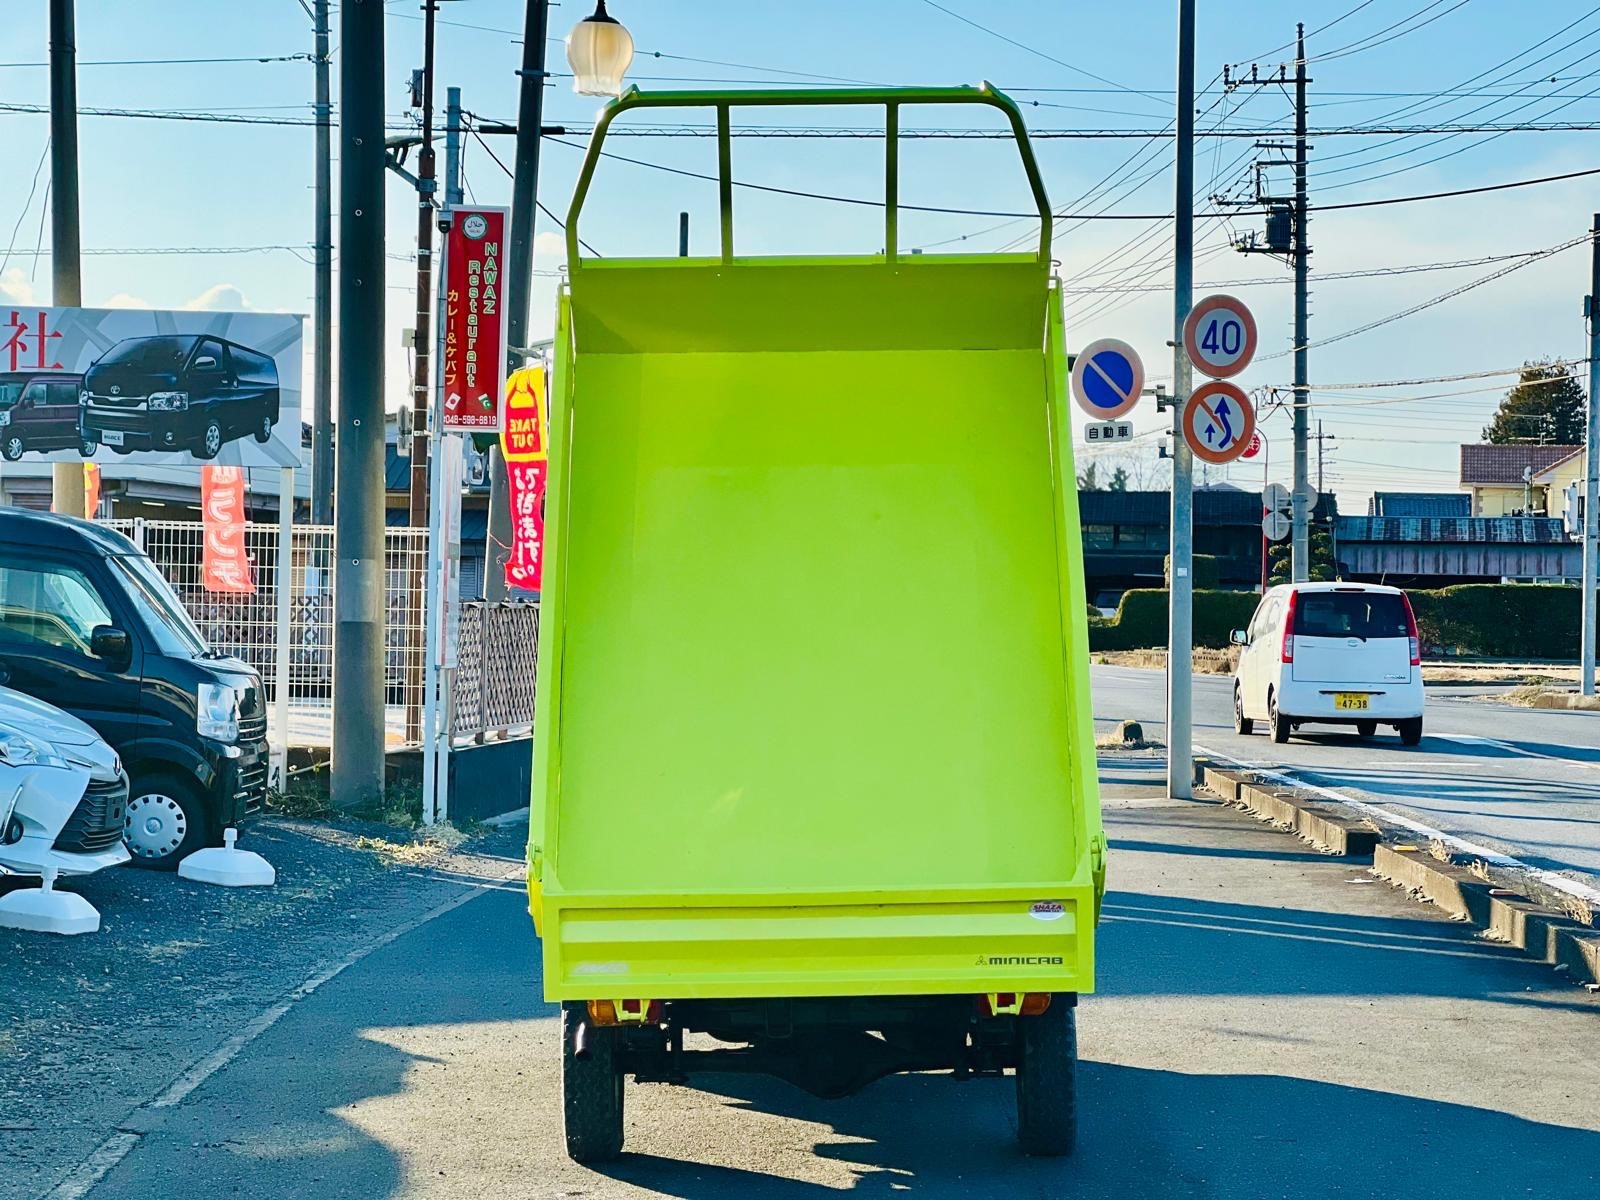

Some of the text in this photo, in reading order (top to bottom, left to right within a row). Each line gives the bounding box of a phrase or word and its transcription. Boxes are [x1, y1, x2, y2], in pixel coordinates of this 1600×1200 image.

[483, 242, 498, 314] NAWAZ
[0, 311, 64, 371] 社
[445, 290, 458, 385] カレー&ケバブ
[466, 260, 481, 387] Restaurant
[1201, 319, 1241, 355] 40
[1089, 426, 1129, 439] 自動車
